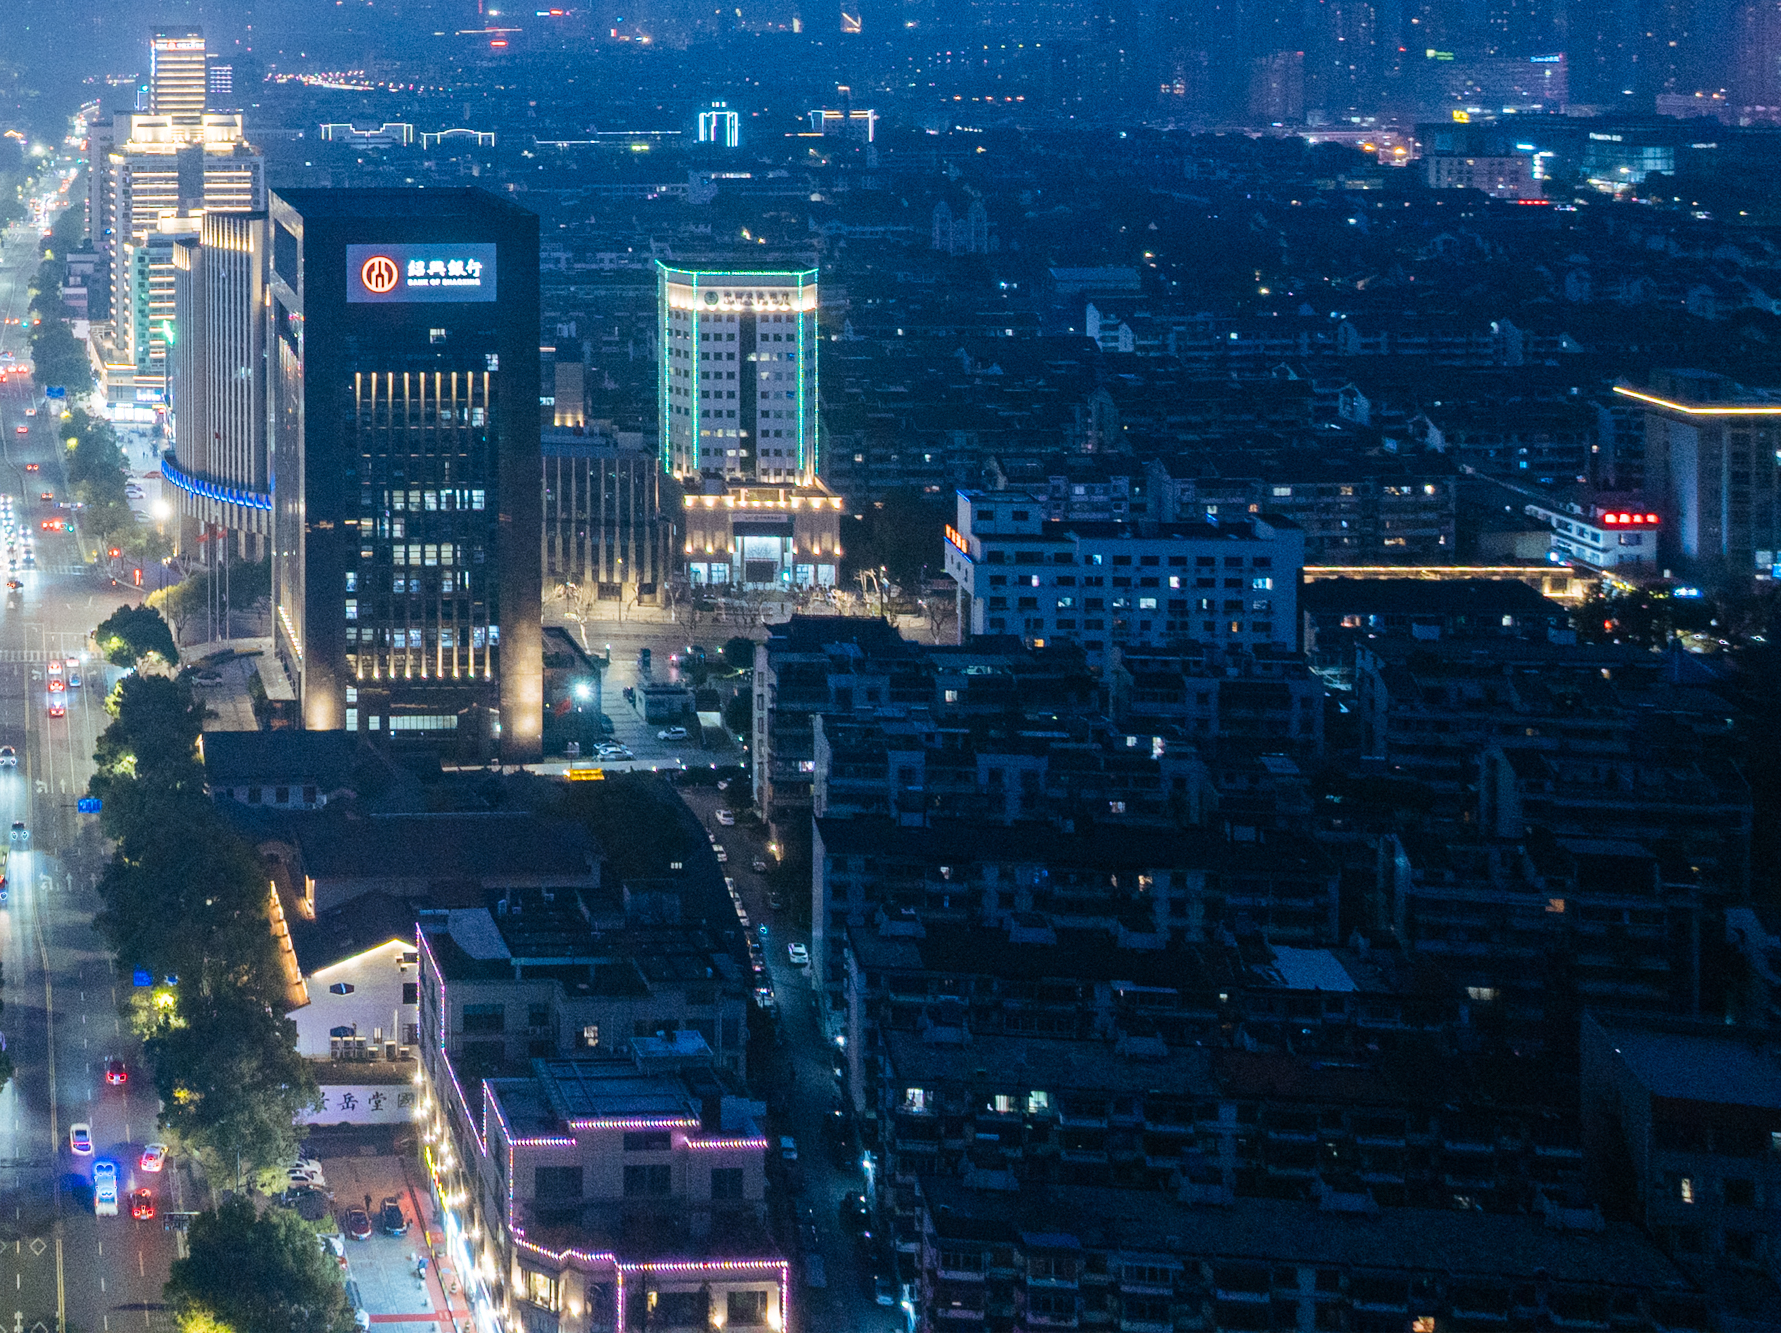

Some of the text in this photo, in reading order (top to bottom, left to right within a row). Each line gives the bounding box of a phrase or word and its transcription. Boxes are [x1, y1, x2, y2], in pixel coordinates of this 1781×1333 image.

[407, 278, 481, 286] BANK OF SHAOXING
